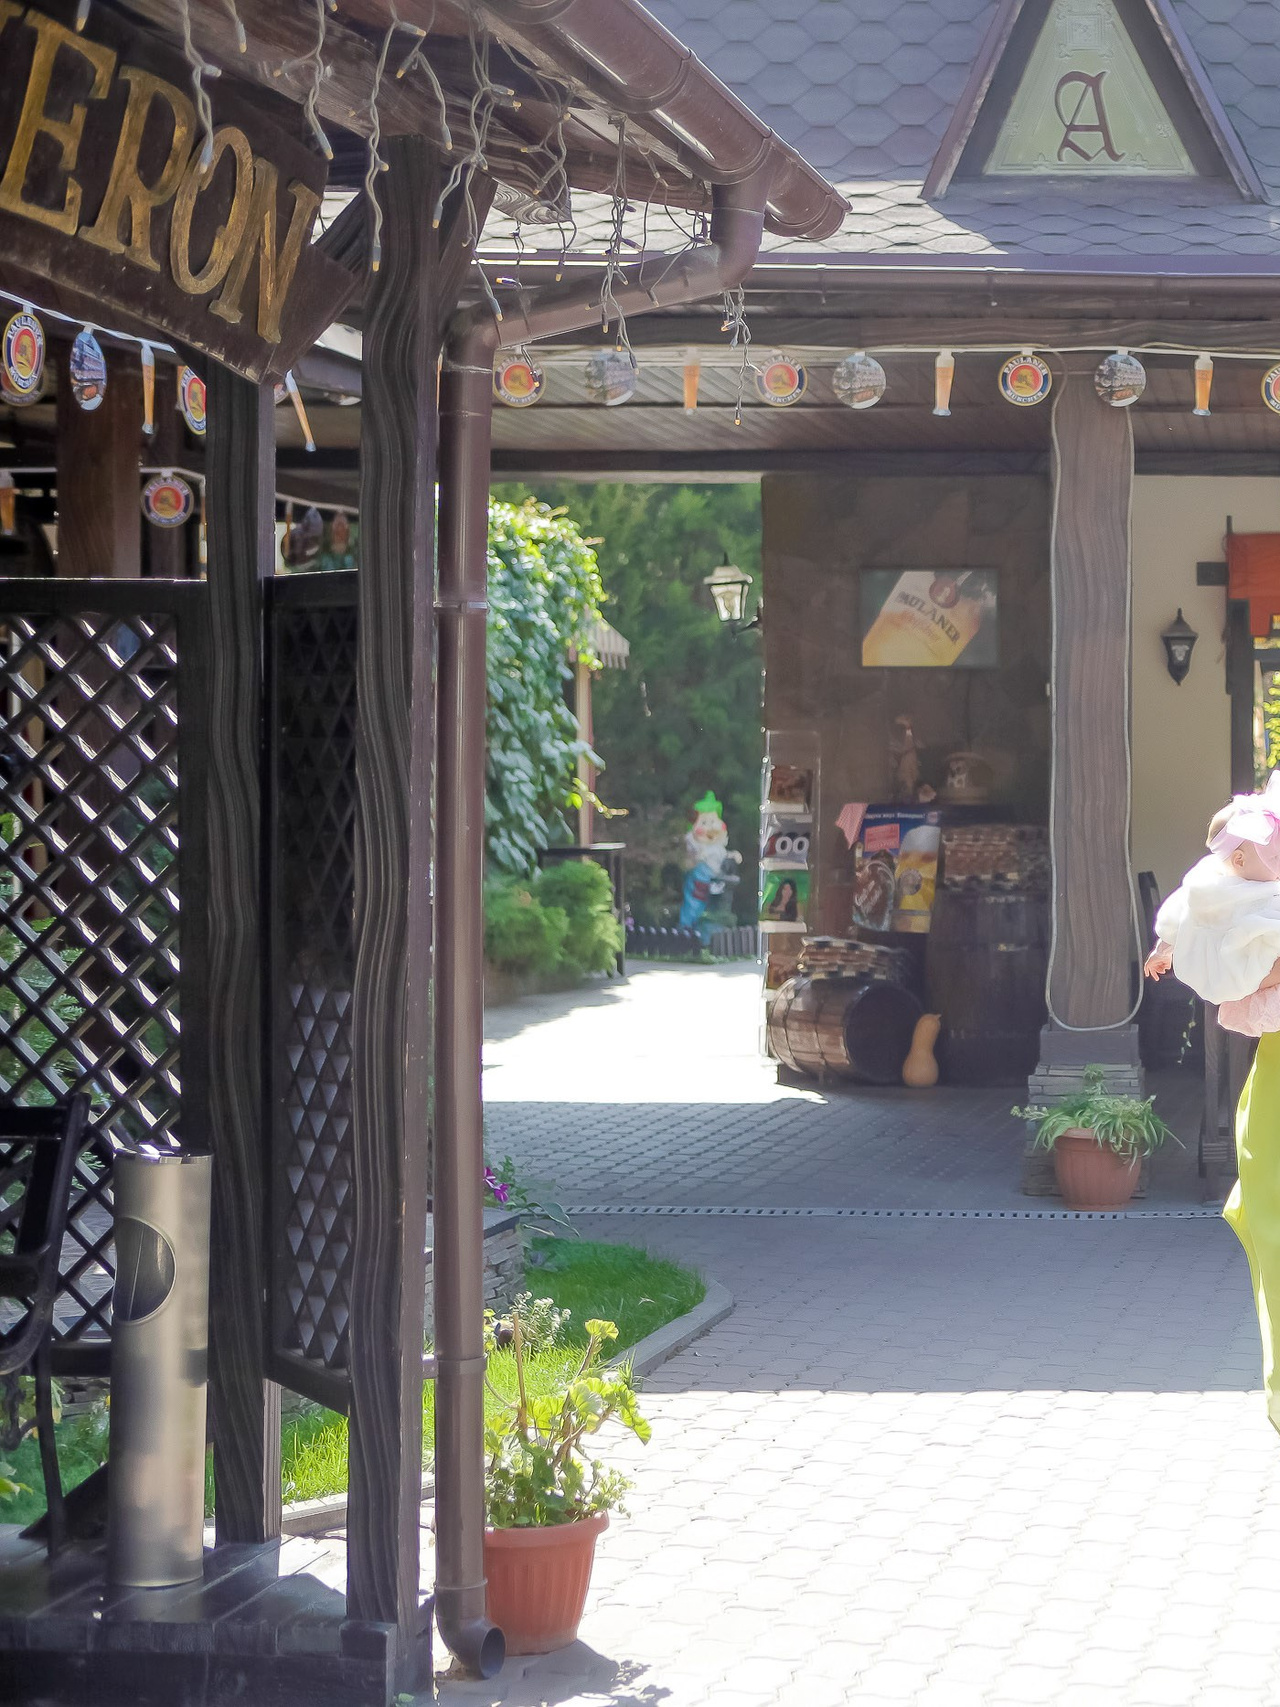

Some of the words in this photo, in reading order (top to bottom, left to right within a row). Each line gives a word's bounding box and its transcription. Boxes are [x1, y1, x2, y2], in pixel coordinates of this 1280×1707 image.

[1055, 71, 1126, 162] A
[0, 3, 322, 343] ERON
[1004, 356, 1048, 375] PAULANER
